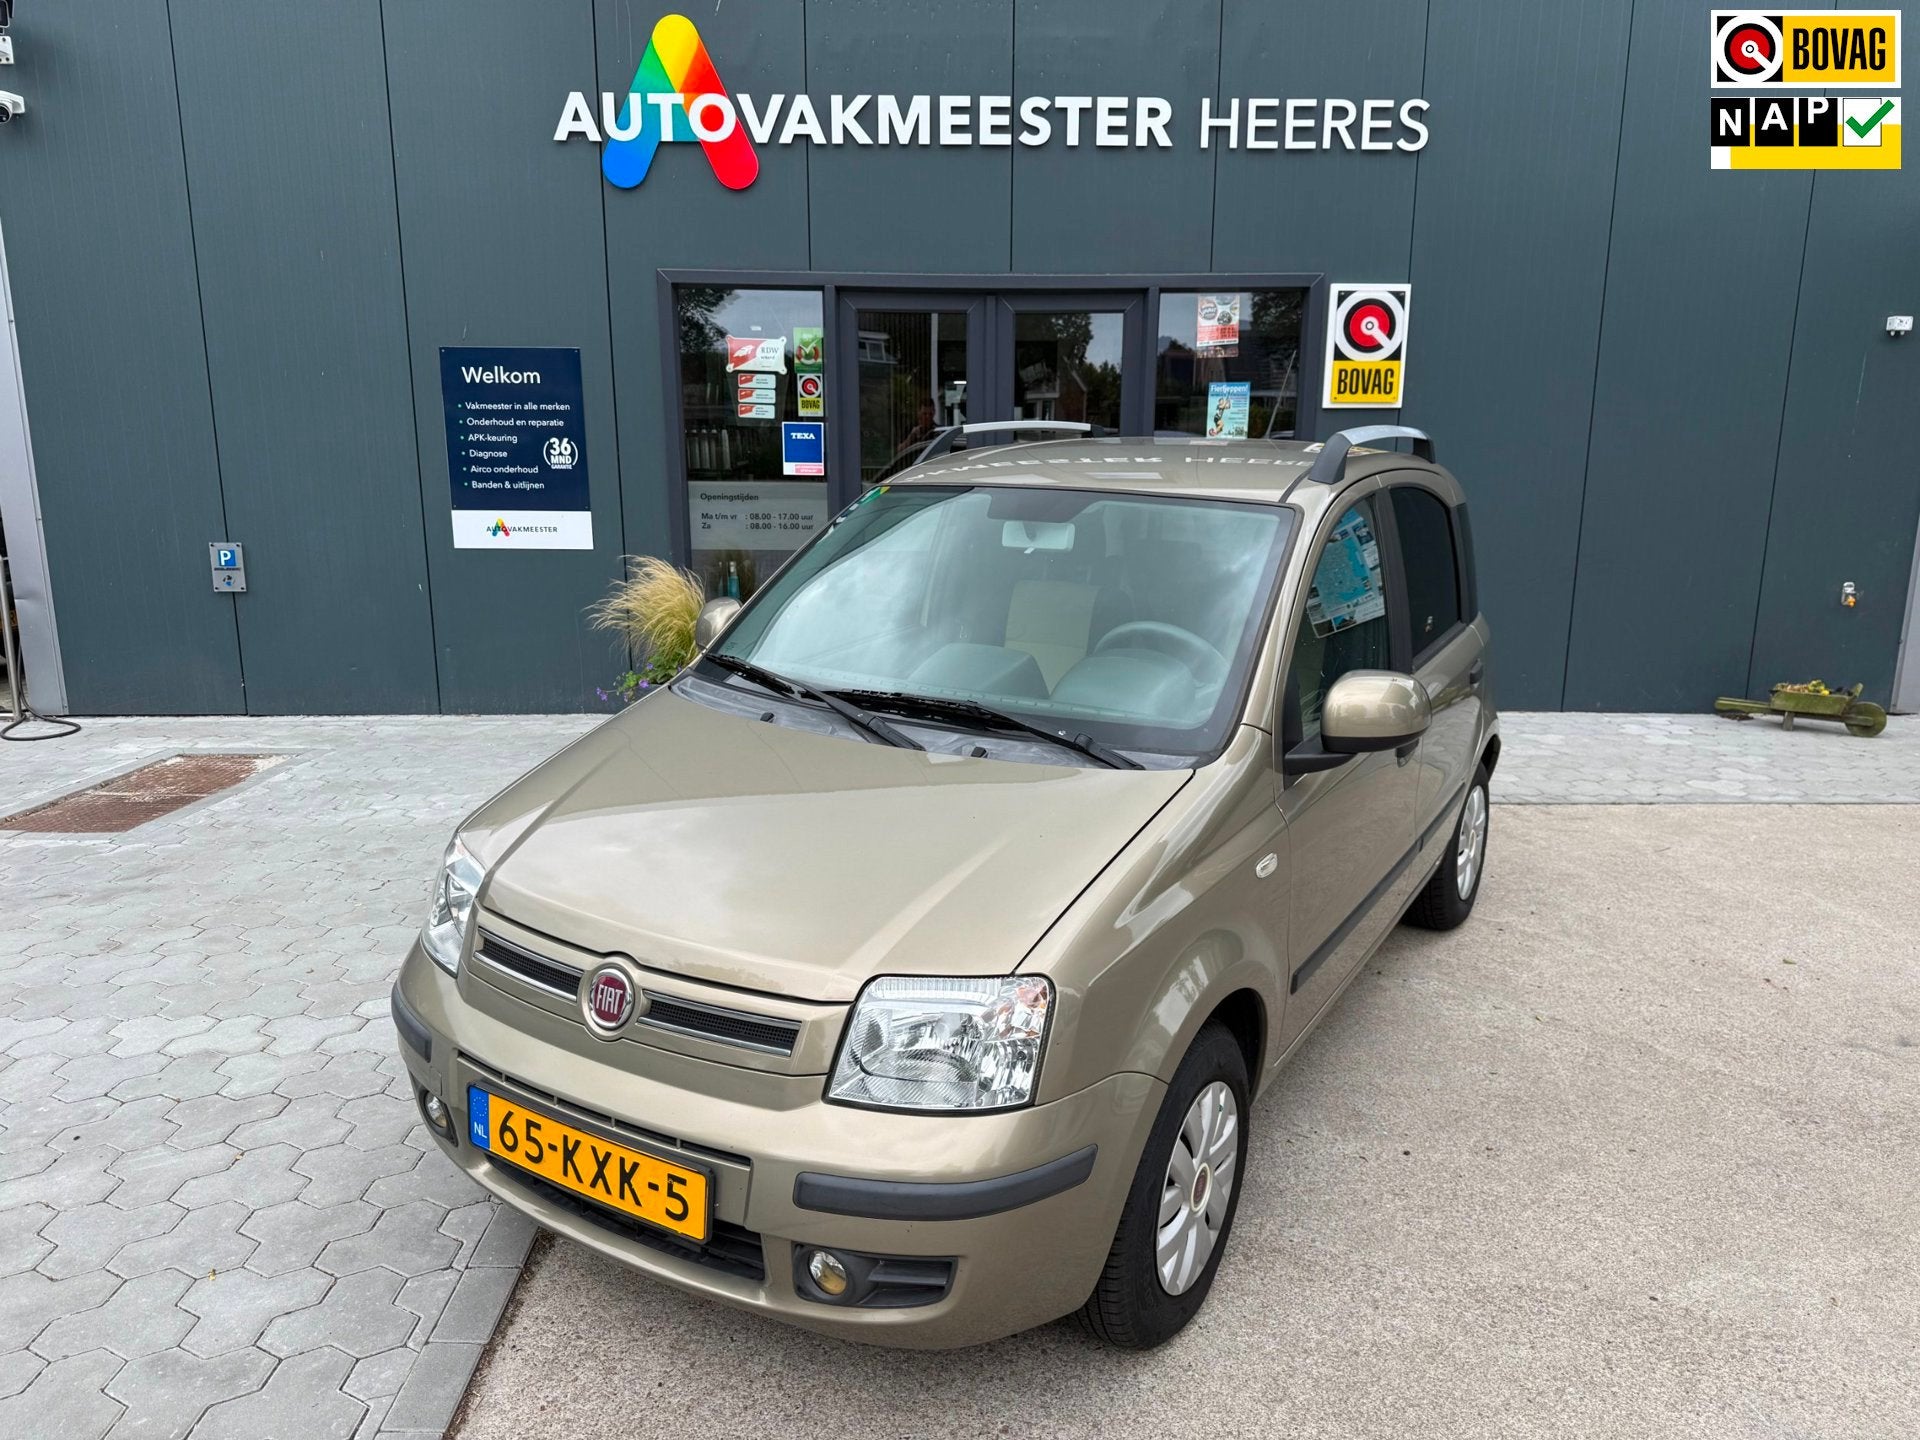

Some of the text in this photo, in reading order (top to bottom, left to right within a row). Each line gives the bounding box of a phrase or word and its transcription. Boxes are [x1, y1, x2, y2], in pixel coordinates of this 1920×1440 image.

[553, 91, 1430, 152] AUTOVAKMEESTER HEERES
[461, 365, 541, 384] Welkom
[1337, 368, 1395, 395] BOVAG
[465, 402, 571, 411] Vakmeester in alle merken
[801, 400, 821, 409] BOVAG
[466, 417, 514, 426] Onderhoud
[528, 418, 564, 428] reparatie
[467, 433, 518, 444] APK-keuring
[790, 432, 816, 440] TEXA
[549, 437, 572, 456] 36
[469, 449, 508, 459] Diagnose
[550, 455, 572, 465] MND
[470, 465, 539, 474] Airco onderhoud
[471, 480, 545, 491] Banden & uitlijnen
[700, 493, 759, 502] Openingstijden
[778, 513, 800, 521] 17.00
[219, 550, 232, 566] P
[595, 984, 624, 1015] FIAT
[473, 1121, 488, 1140] NL
[499, 1110, 690, 1222] 65-KXK-5
